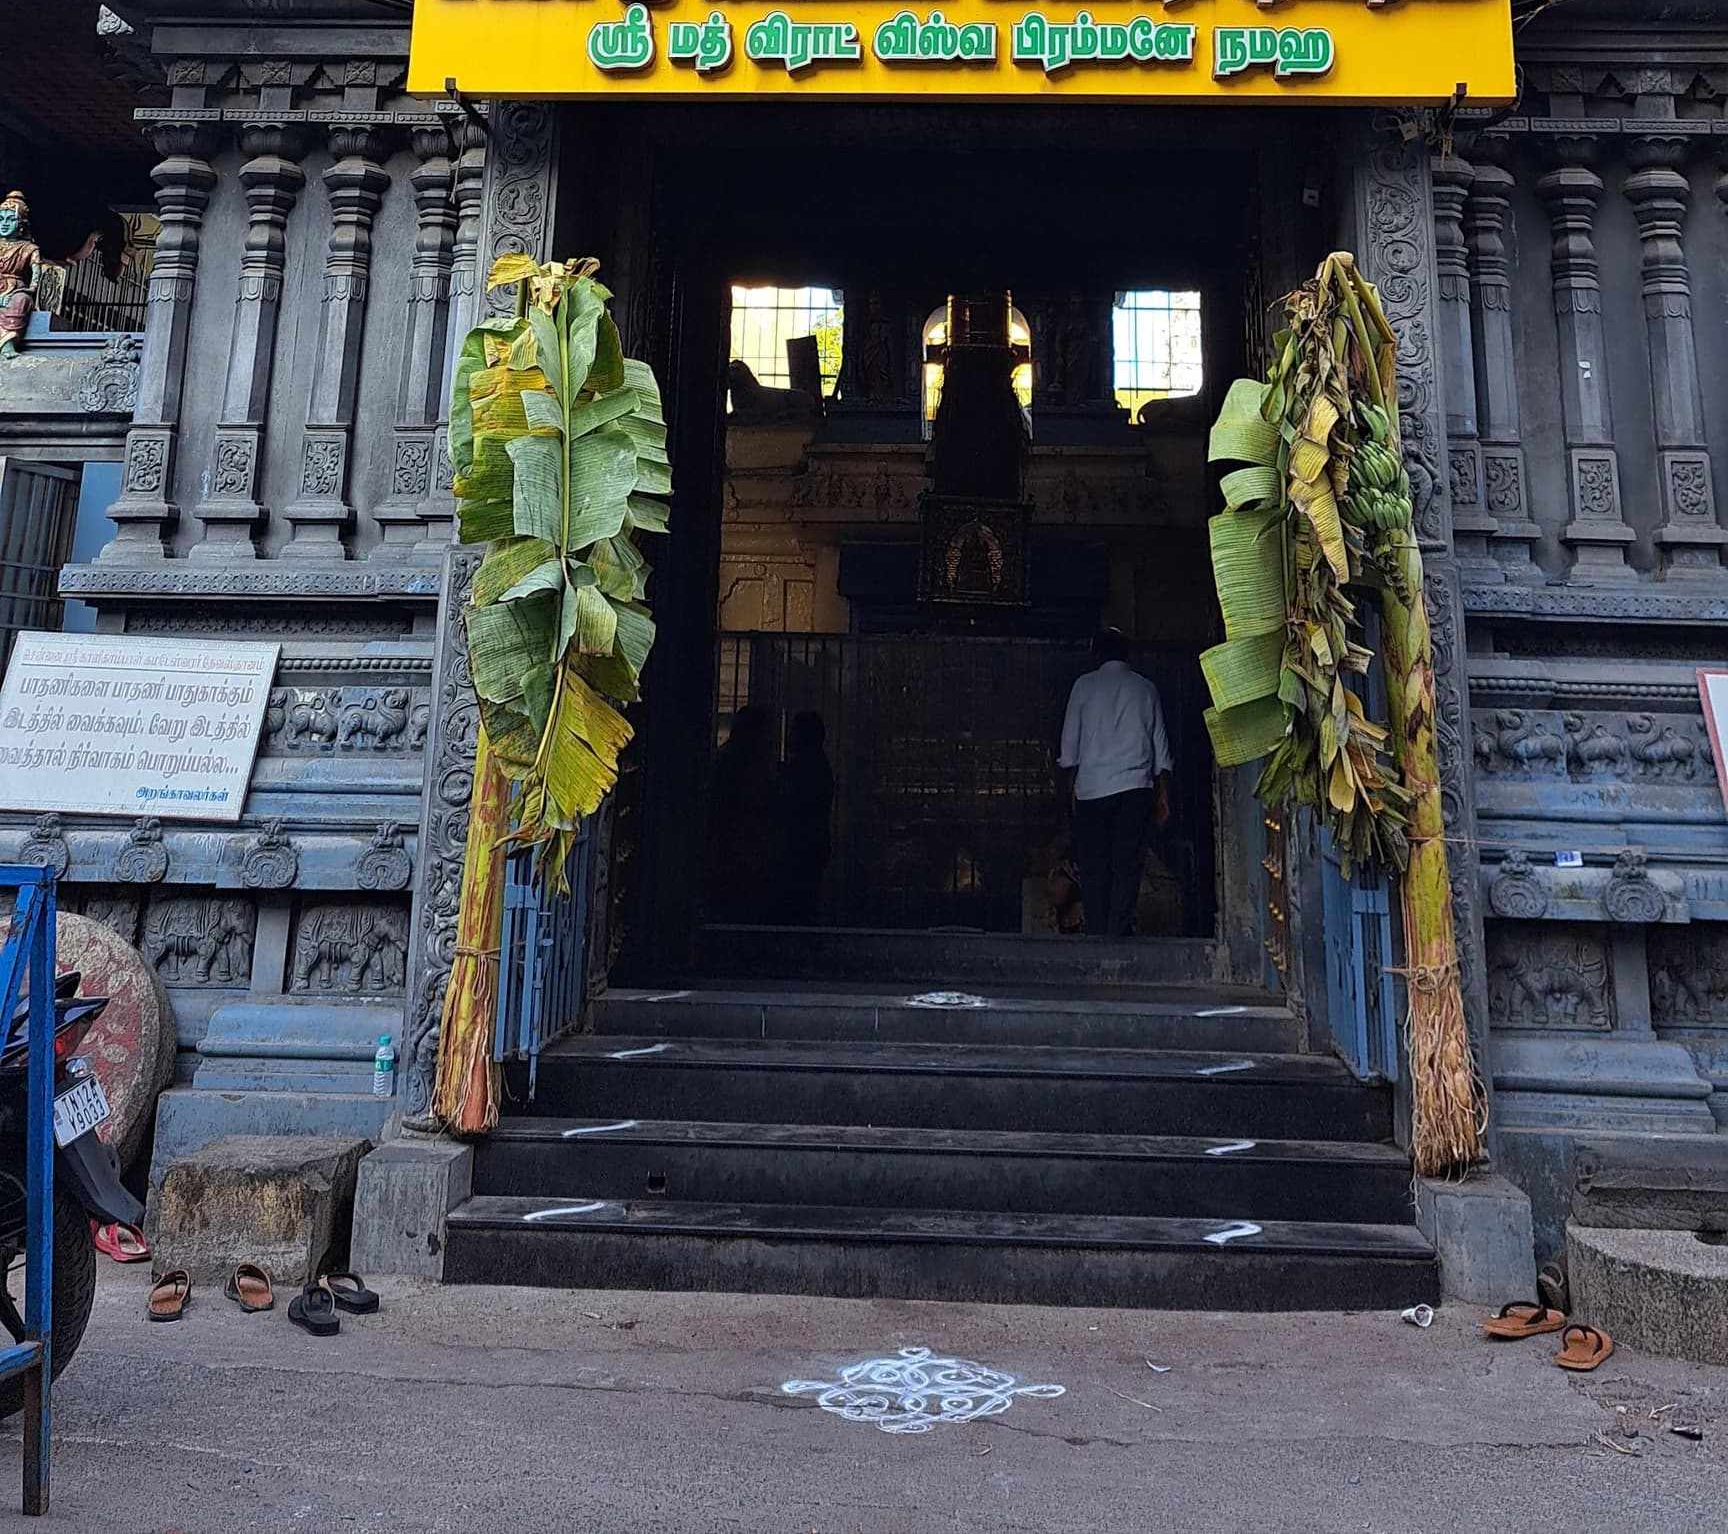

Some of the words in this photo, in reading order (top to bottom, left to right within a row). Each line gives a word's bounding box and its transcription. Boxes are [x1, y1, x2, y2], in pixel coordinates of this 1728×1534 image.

[590, 6, 650, 66] ஸ்ரீ
[670, 14, 728, 67] மத்
[747, 13, 860, 67] விராட்
[876, 12, 995, 57] விஸ்வ
[1015, 13, 1192, 68] பிரம்மனே
[1217, 29, 1331, 73] நமஹ
[19, 672, 112, 699] பாதணிகளை
[112, 676, 165, 705] பாதணி
[165, 678, 255, 708] பாதுகாக்கும்
[2, 704, 65, 734] இடத்தில்
[148, 712, 189, 744] வேறு
[189, 711, 251, 744] இடத்தில்
[64, 740, 136, 774] நிர்வாகம்
[68, 1098, 106, 1135] Y9033
